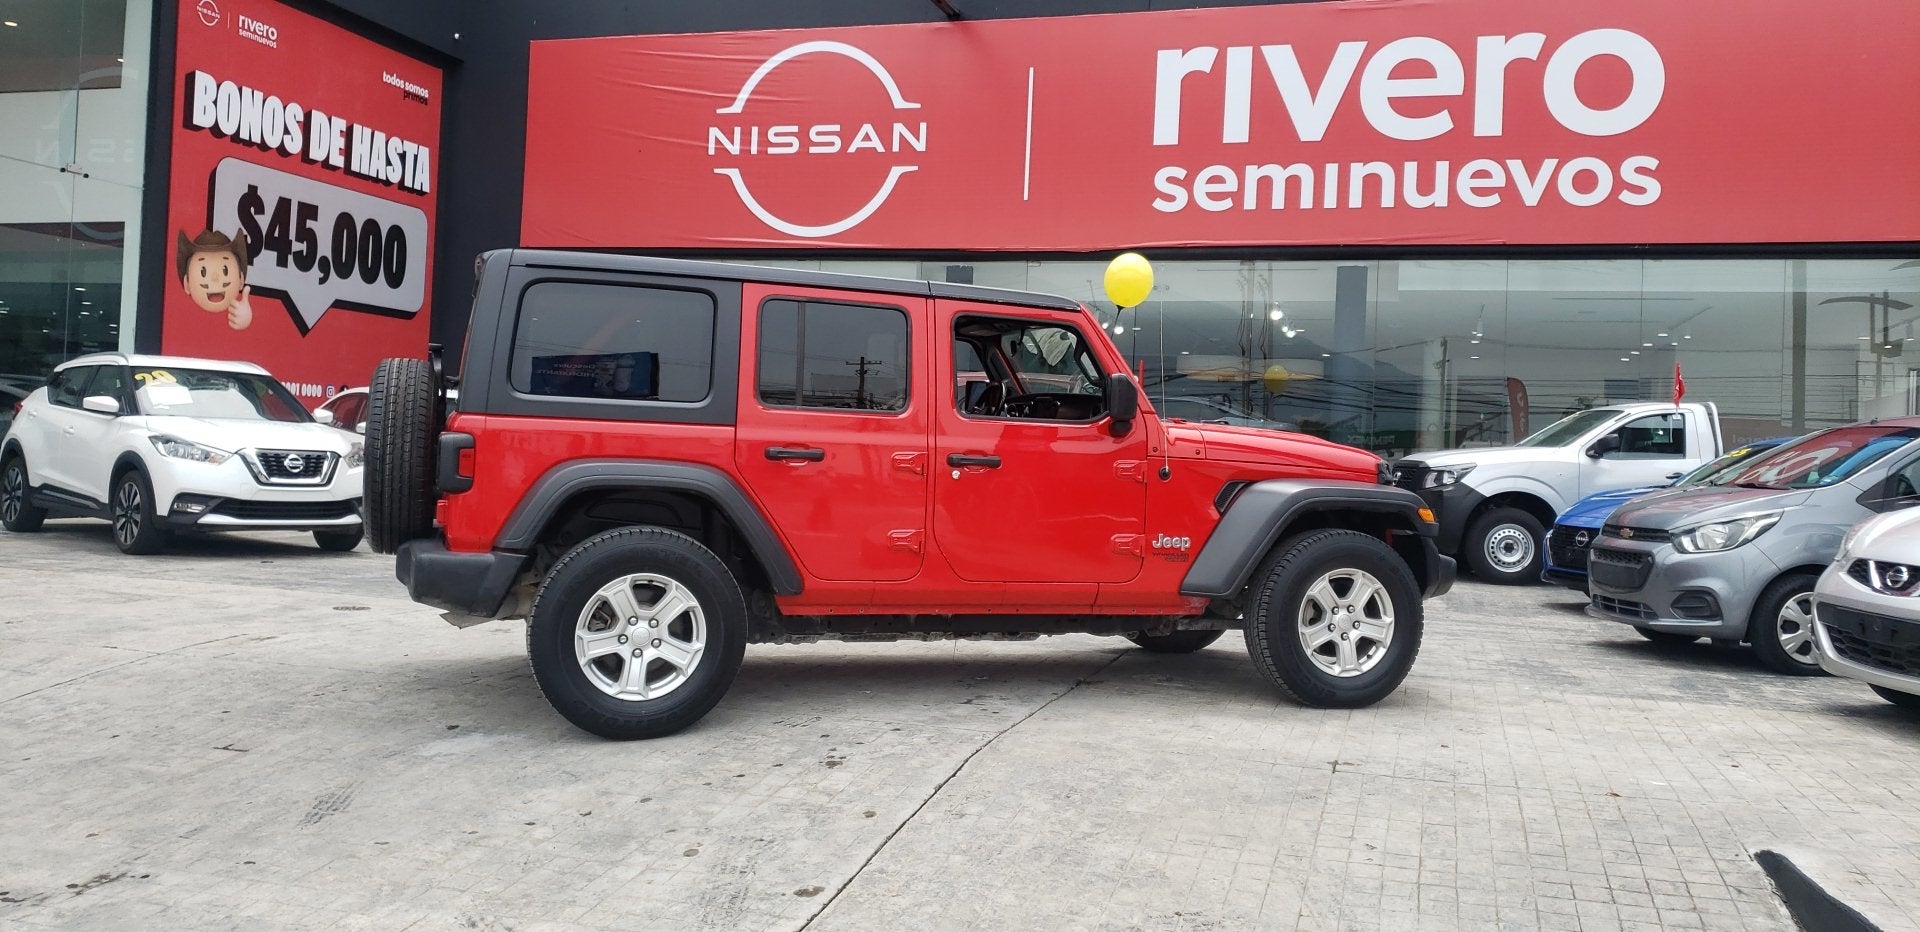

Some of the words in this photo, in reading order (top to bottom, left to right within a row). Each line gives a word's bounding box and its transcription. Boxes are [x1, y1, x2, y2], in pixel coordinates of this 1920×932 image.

[197, 5, 220, 19] NISSAN
[239, 14, 277, 40] rivero
[239, 28, 277, 49] seminuevos
[383, 70, 404, 89] todos
[405, 82, 429, 98] somos
[403, 90, 428, 105] primos
[1152, 28, 1666, 146] rivero
[192, 69, 304, 155] BONOS
[309, 109, 347, 168] DE
[350, 122, 430, 193] HASTA
[707, 122, 927, 156] NISSAN
[1152, 155, 1662, 213] seminuevos
[237, 184, 408, 290] $45,000
[301, 383, 323, 398] 0000
[1152, 533, 1191, 551] Jeep
